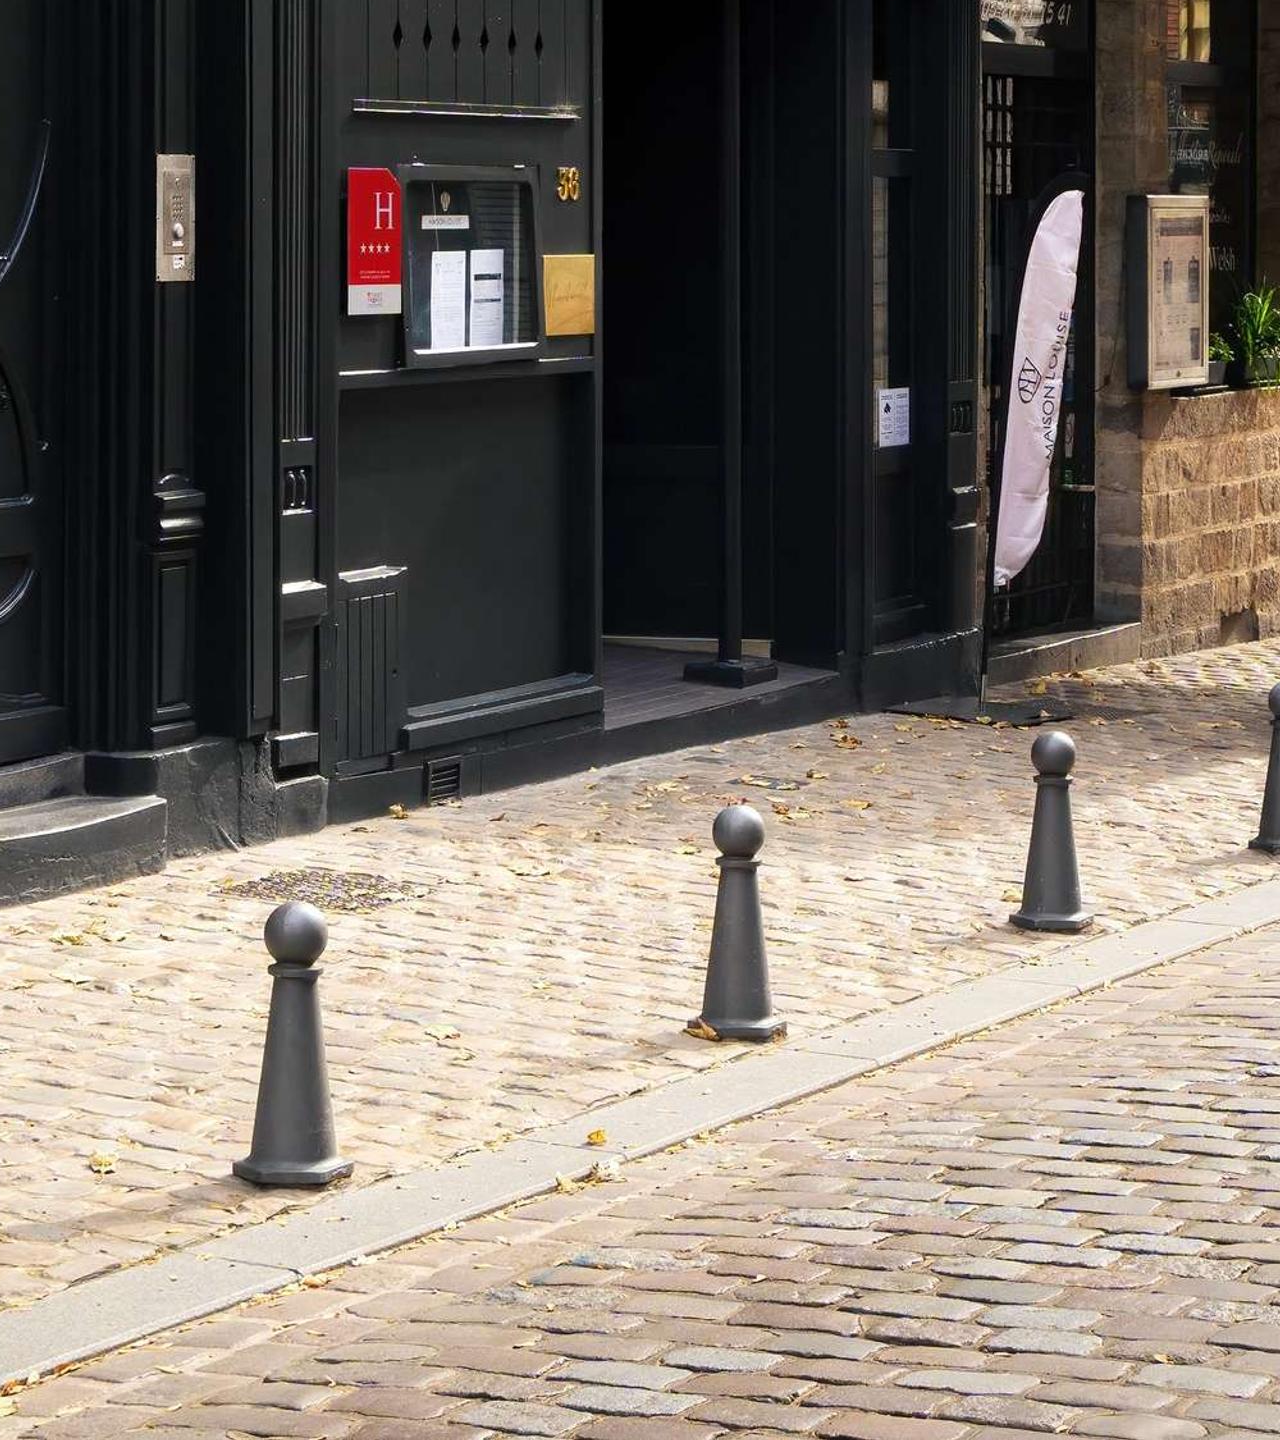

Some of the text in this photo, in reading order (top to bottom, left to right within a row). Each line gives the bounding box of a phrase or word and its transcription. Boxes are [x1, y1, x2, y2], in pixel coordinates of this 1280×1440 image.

[374, 191, 395, 230] H
[1042, 311, 1070, 460] MAISON LOUISE
